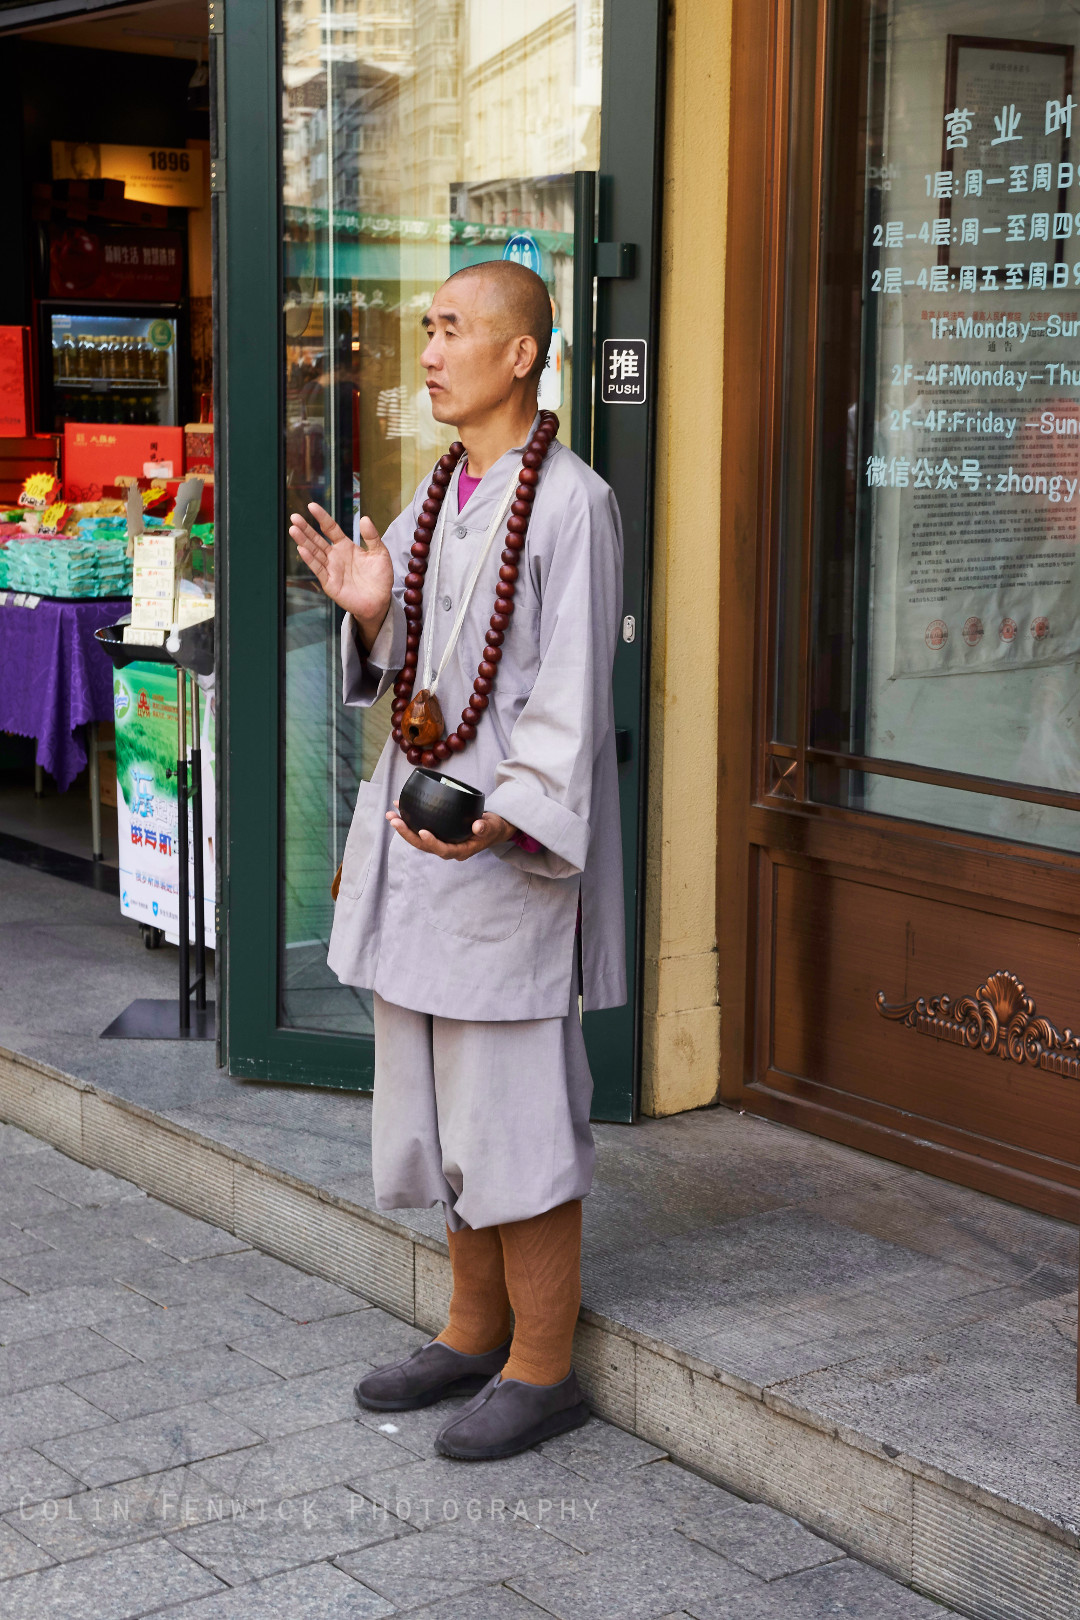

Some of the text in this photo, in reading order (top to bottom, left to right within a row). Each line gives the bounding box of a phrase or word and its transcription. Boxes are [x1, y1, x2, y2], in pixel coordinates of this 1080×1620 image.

[149, 151, 190, 172] 1896
[609, 349, 640, 380] 推
[608, 384, 640, 395] PUSH
[866, 455, 1080, 503] 微信公众号:zhongy
